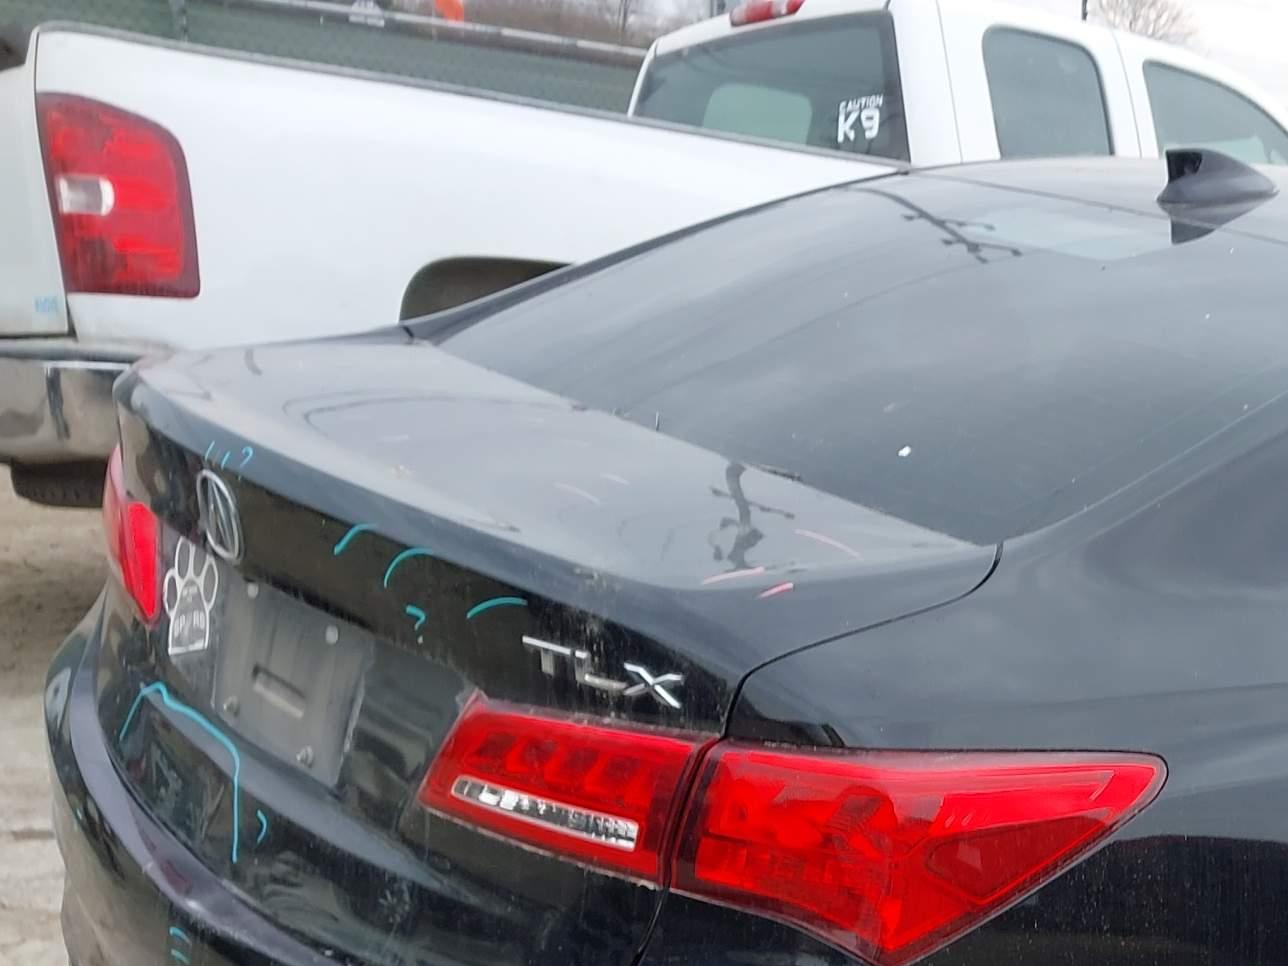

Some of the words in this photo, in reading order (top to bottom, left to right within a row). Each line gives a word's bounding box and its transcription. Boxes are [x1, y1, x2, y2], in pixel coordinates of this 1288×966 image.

[838, 93, 884, 112] CAUTION
[837, 107, 881, 143] K9
[522, 635, 685, 709] TLX
